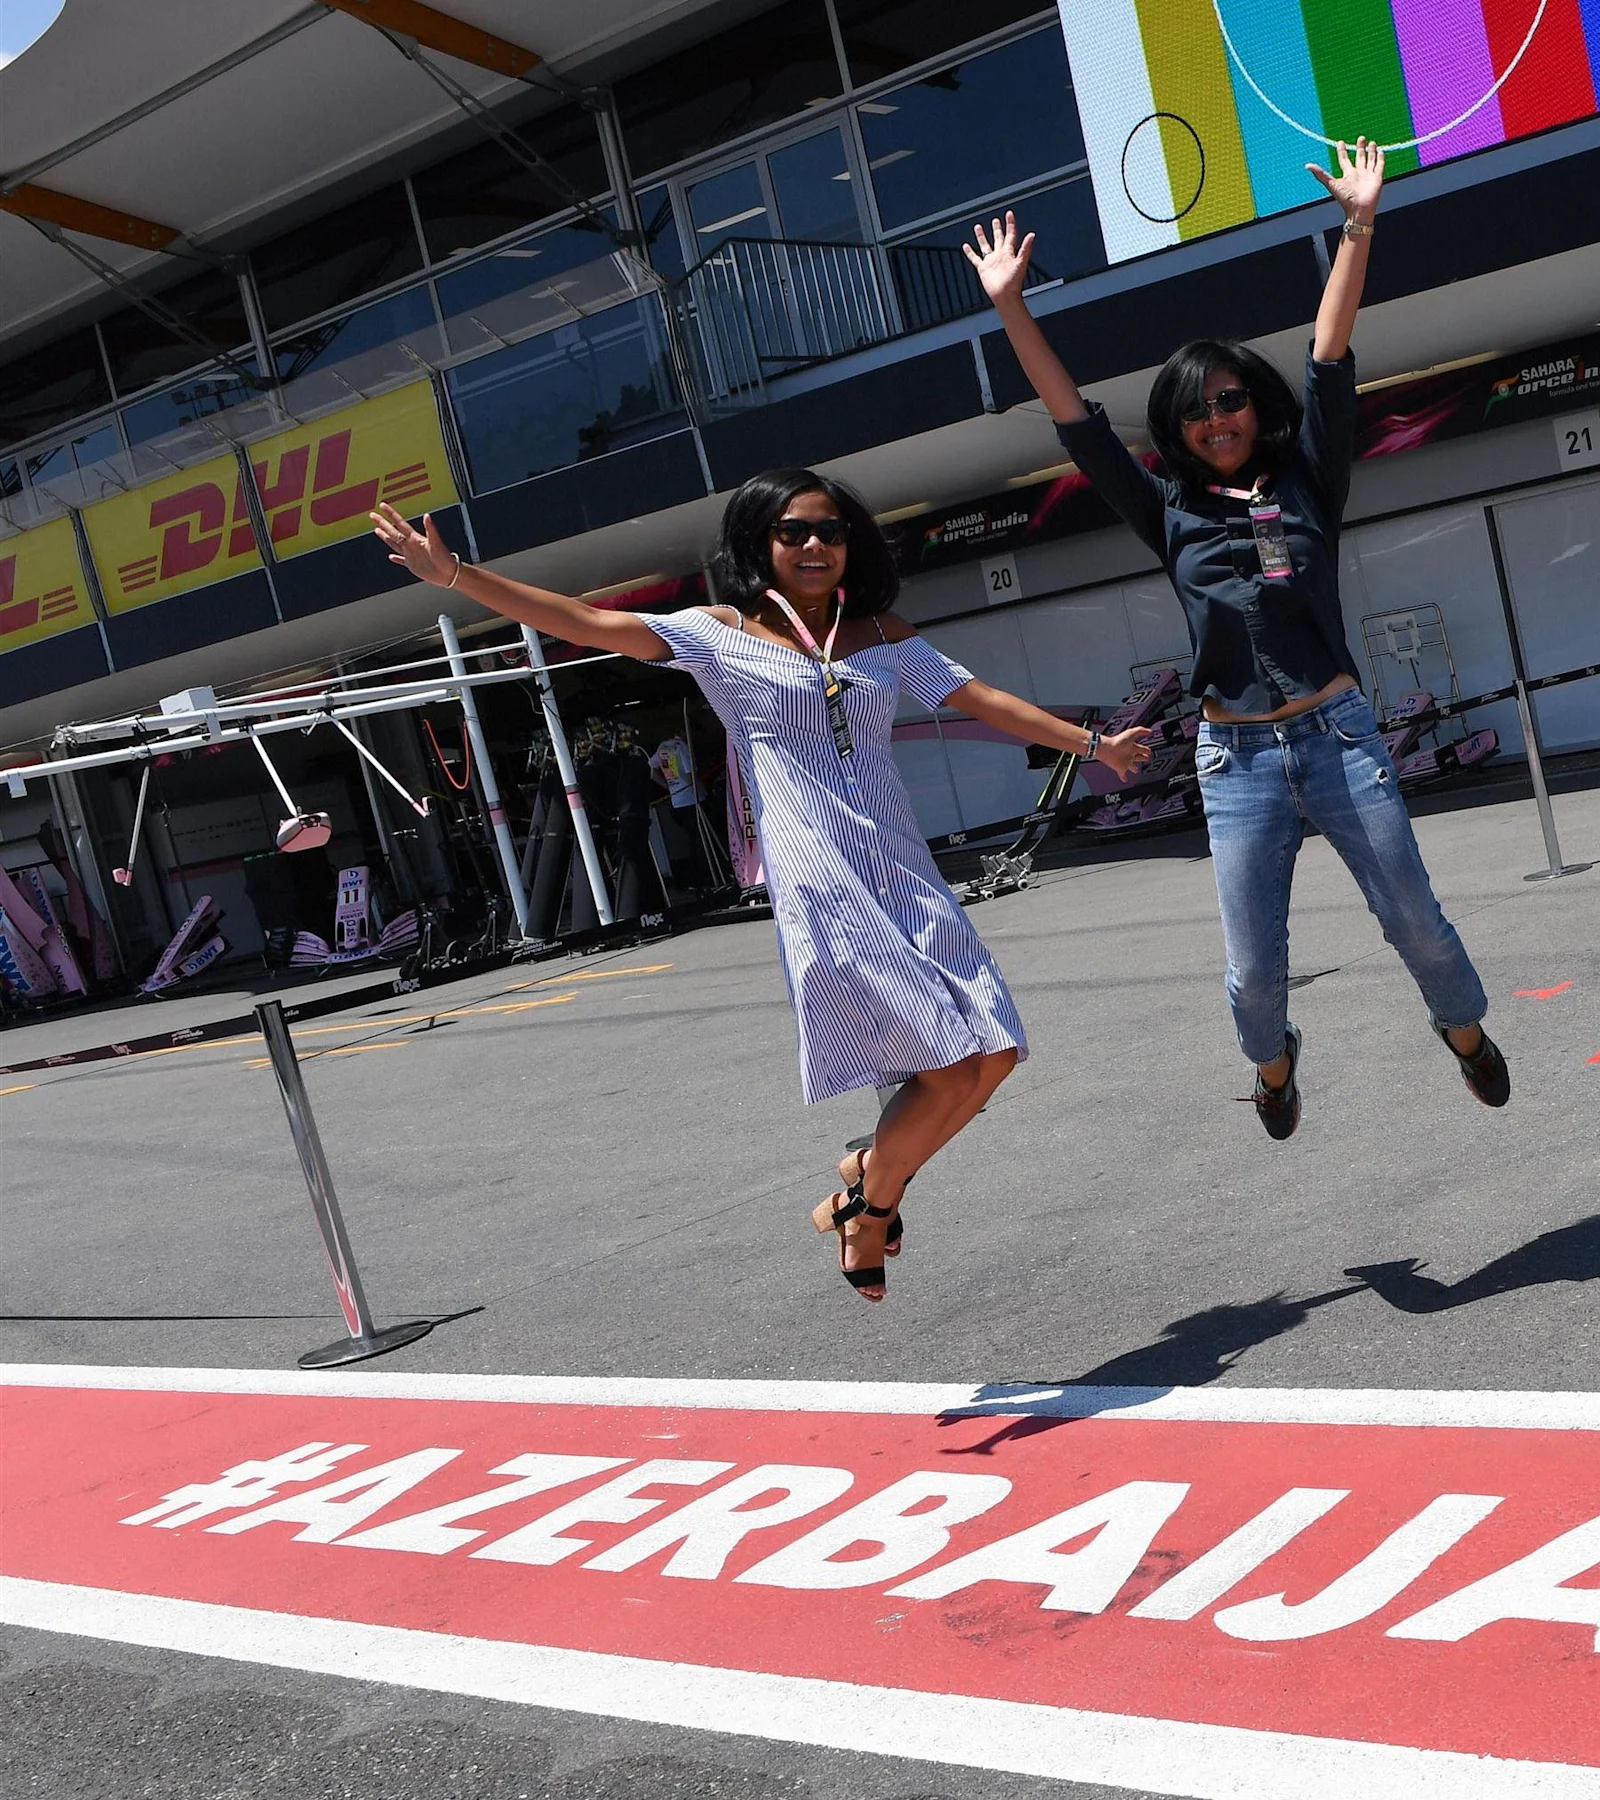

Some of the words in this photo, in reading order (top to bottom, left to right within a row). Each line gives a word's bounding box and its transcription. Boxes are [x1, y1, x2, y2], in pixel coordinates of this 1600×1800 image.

[1520, 356, 1576, 382] SAHARA
[1549, 386, 1575, 398] formula
[1575, 382, 1588, 392] one
[1564, 426, 1593, 456] 21
[149, 428, 379, 582] DHL
[945, 511, 985, 531] SAHARA
[990, 567, 1012, 591] 20
[948, 832, 968, 846] flex
[342, 879, 363, 889] BWT
[343, 888, 360, 904] 11
[639, 912, 664, 928] flex
[195, 945, 218, 965] BWT
[392, 977, 421, 994] flex
